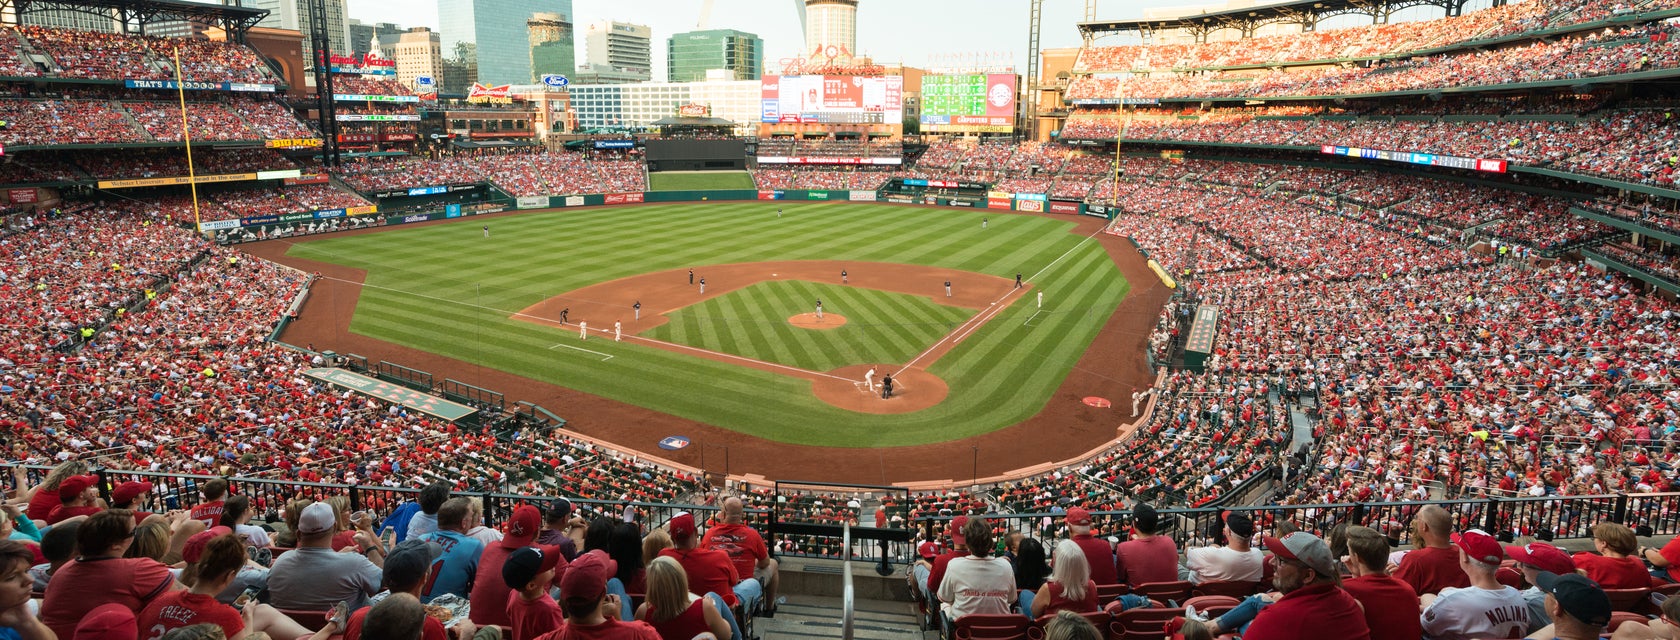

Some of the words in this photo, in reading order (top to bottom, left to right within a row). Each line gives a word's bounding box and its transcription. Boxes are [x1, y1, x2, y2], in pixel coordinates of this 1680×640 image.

[358, 53, 395, 69] Nation
[549, 74, 565, 85] Ford
[468, 96, 489, 104] BREW
[490, 96, 513, 104] HOUSE
[273, 139, 291, 148] BIG
[293, 138, 318, 147] MAC
[159, 605, 197, 624] FREESE
[1485, 605, 1528, 627] MOLINA
